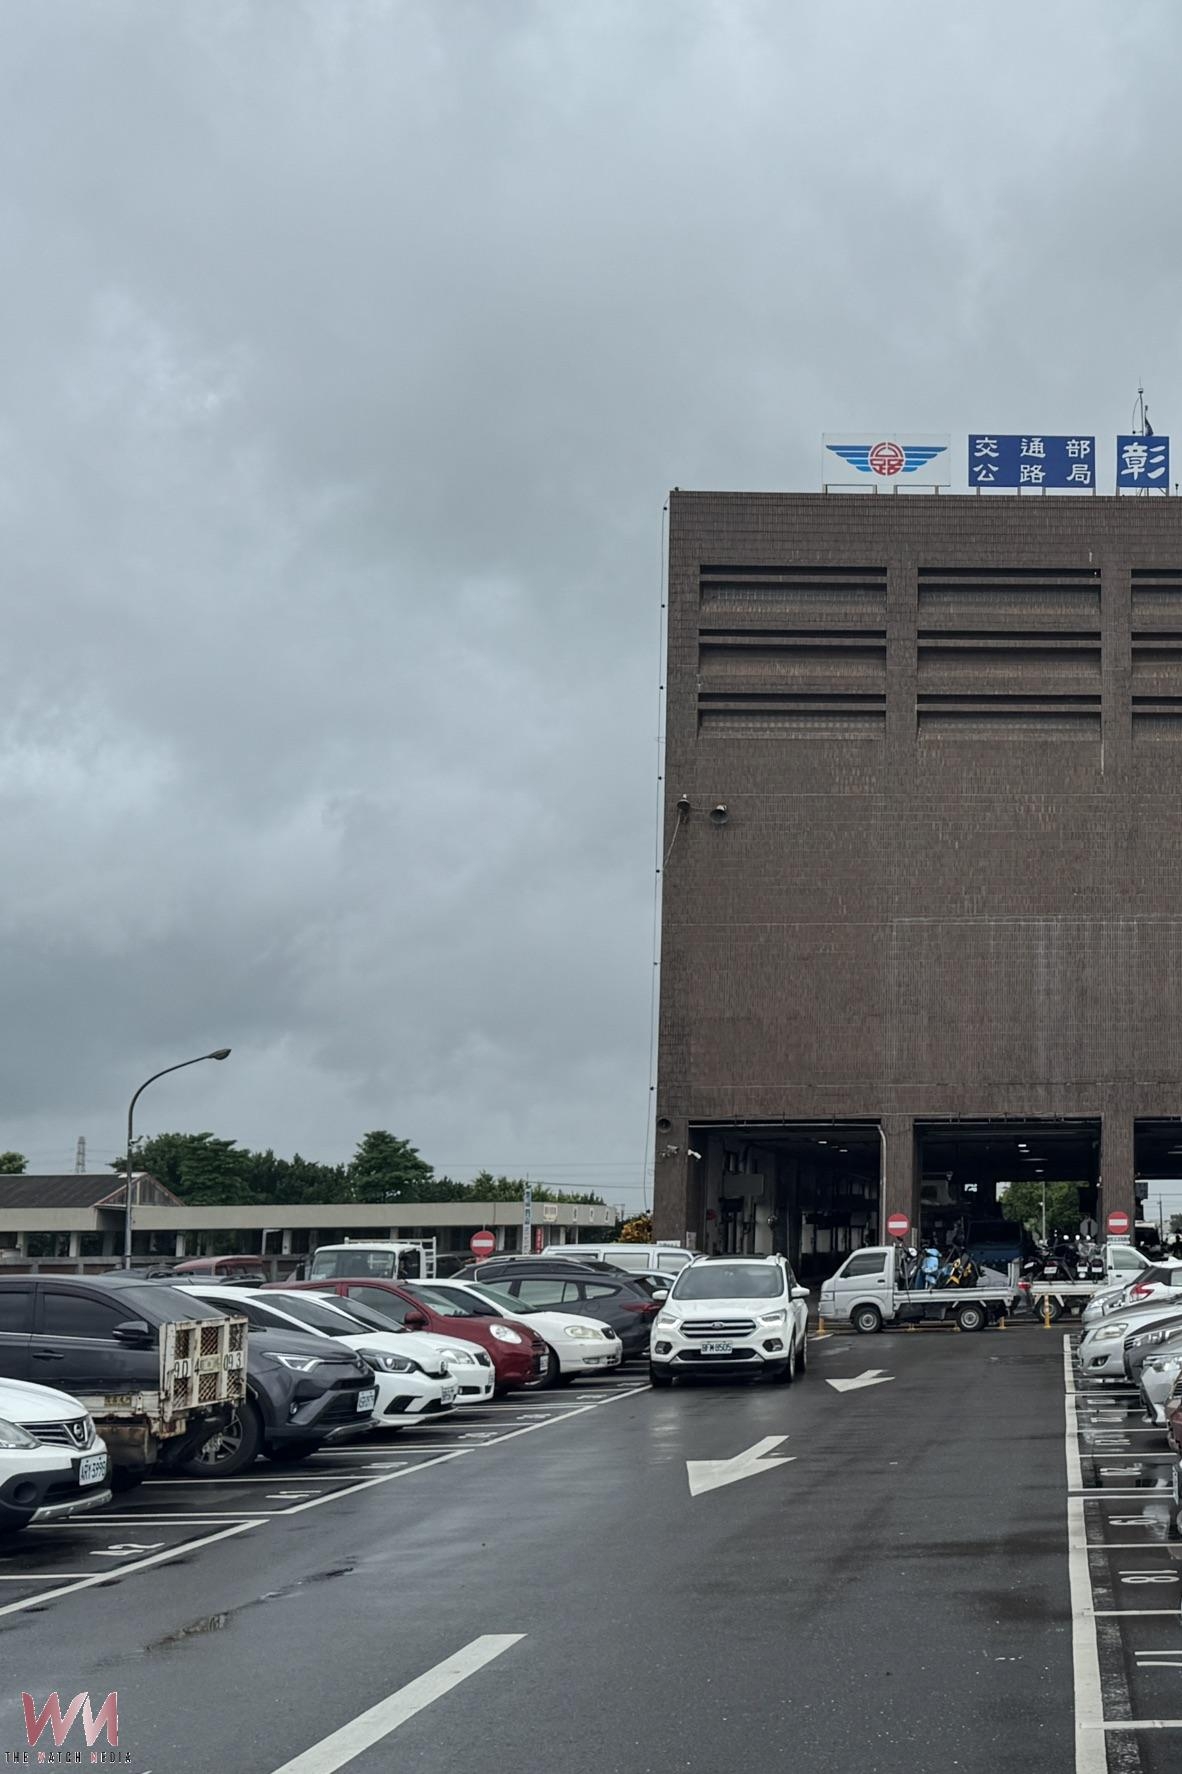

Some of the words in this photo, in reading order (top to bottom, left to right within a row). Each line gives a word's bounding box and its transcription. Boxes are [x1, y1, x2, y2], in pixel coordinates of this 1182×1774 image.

[973, 436, 1091, 459] 交通部
[973, 463, 1091, 484] 公路局
[265, 1489, 322, 1499] 41
[1108, 1514, 1158, 1526] 19
[89, 1542, 165, 1557] 42
[1118, 1569, 1180, 1584] 18
